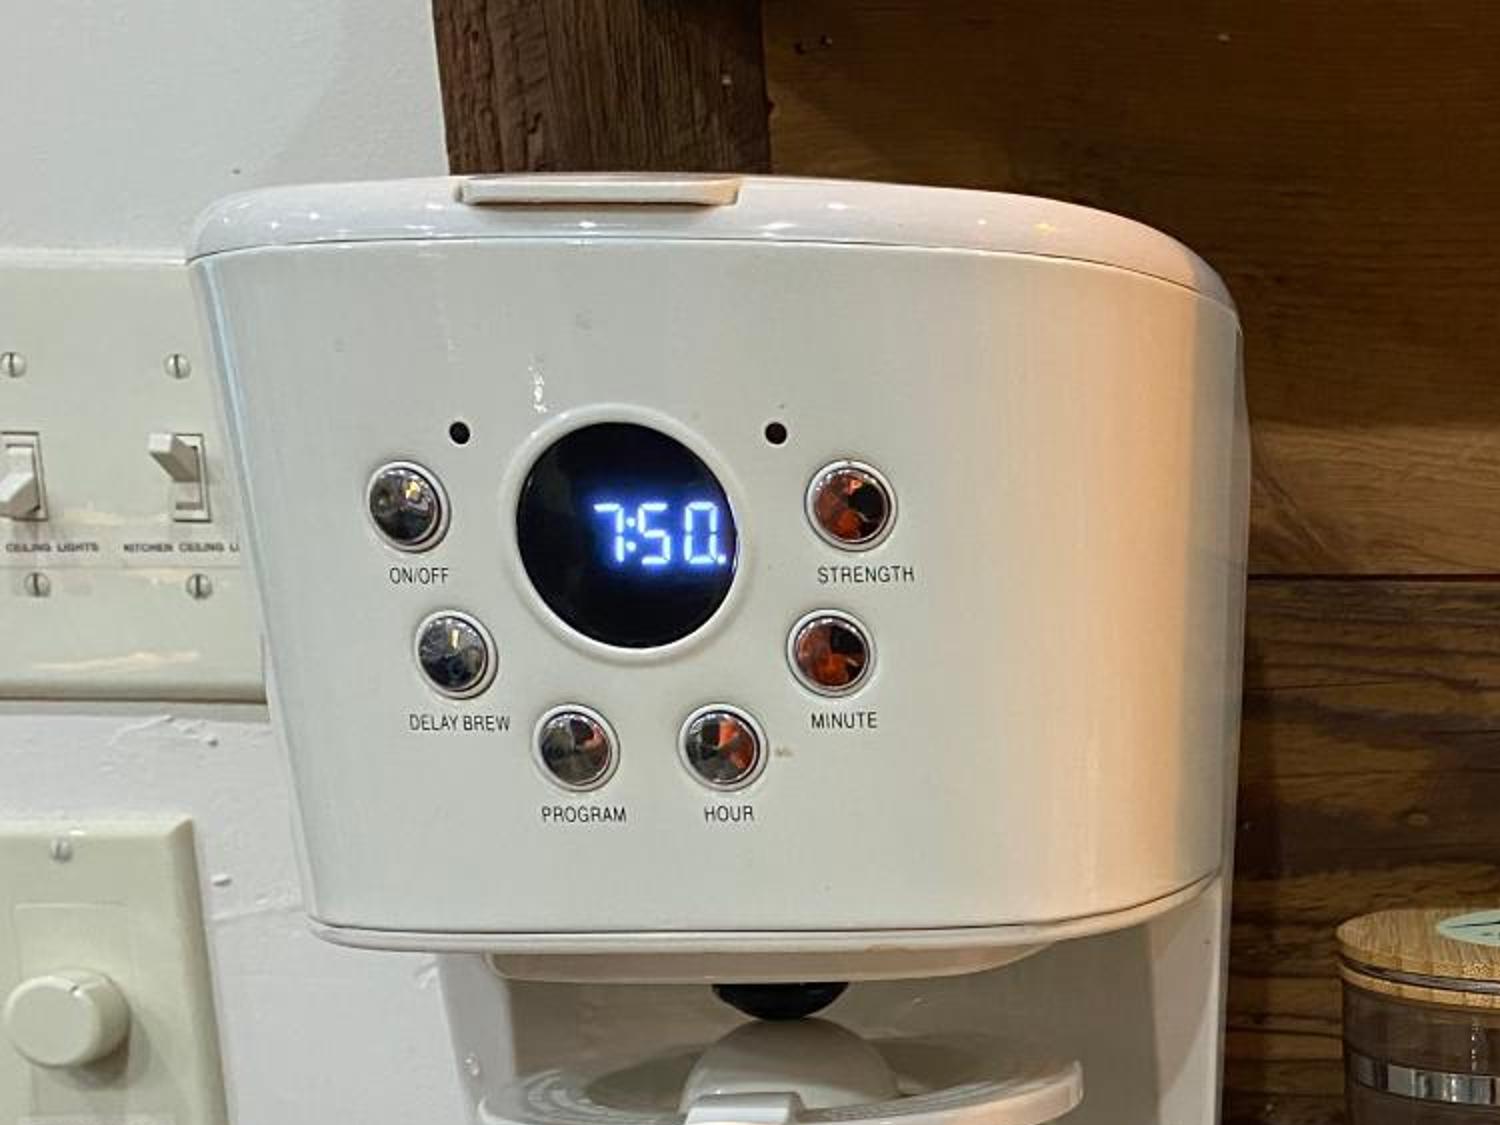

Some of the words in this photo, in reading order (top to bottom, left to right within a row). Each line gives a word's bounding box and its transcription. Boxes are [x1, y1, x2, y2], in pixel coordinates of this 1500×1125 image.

[388, 567, 449, 585] ON/OFF
[817, 565, 915, 584] STRENGTH
[409, 714, 458, 731] DELAY
[463, 715, 511, 731] BREW
[811, 711, 878, 730] MINUTE
[541, 806, 627, 823] PROGRAM
[704, 806, 754, 822] HOUR
